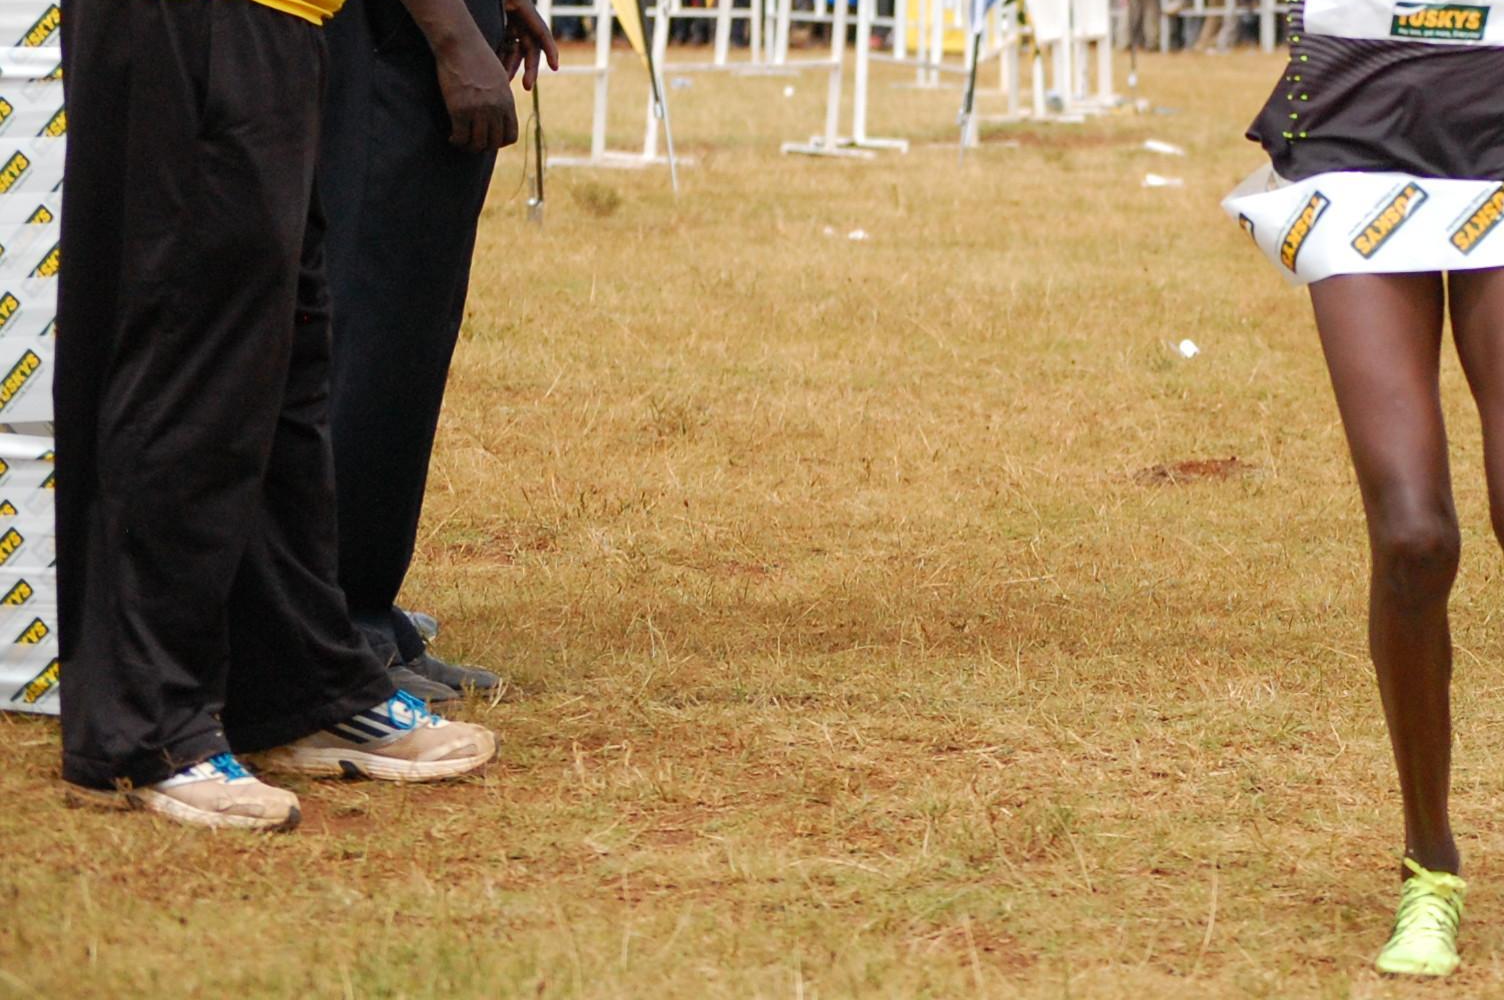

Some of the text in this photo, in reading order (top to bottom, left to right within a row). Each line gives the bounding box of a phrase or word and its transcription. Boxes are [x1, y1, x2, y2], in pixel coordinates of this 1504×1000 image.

[25, 7, 61, 46] SKYS
[1398, 7, 1482, 30] TUSKYS
[1354, 186, 1416, 255] TUSKYS
[0, 352, 40, 409] USKYS
